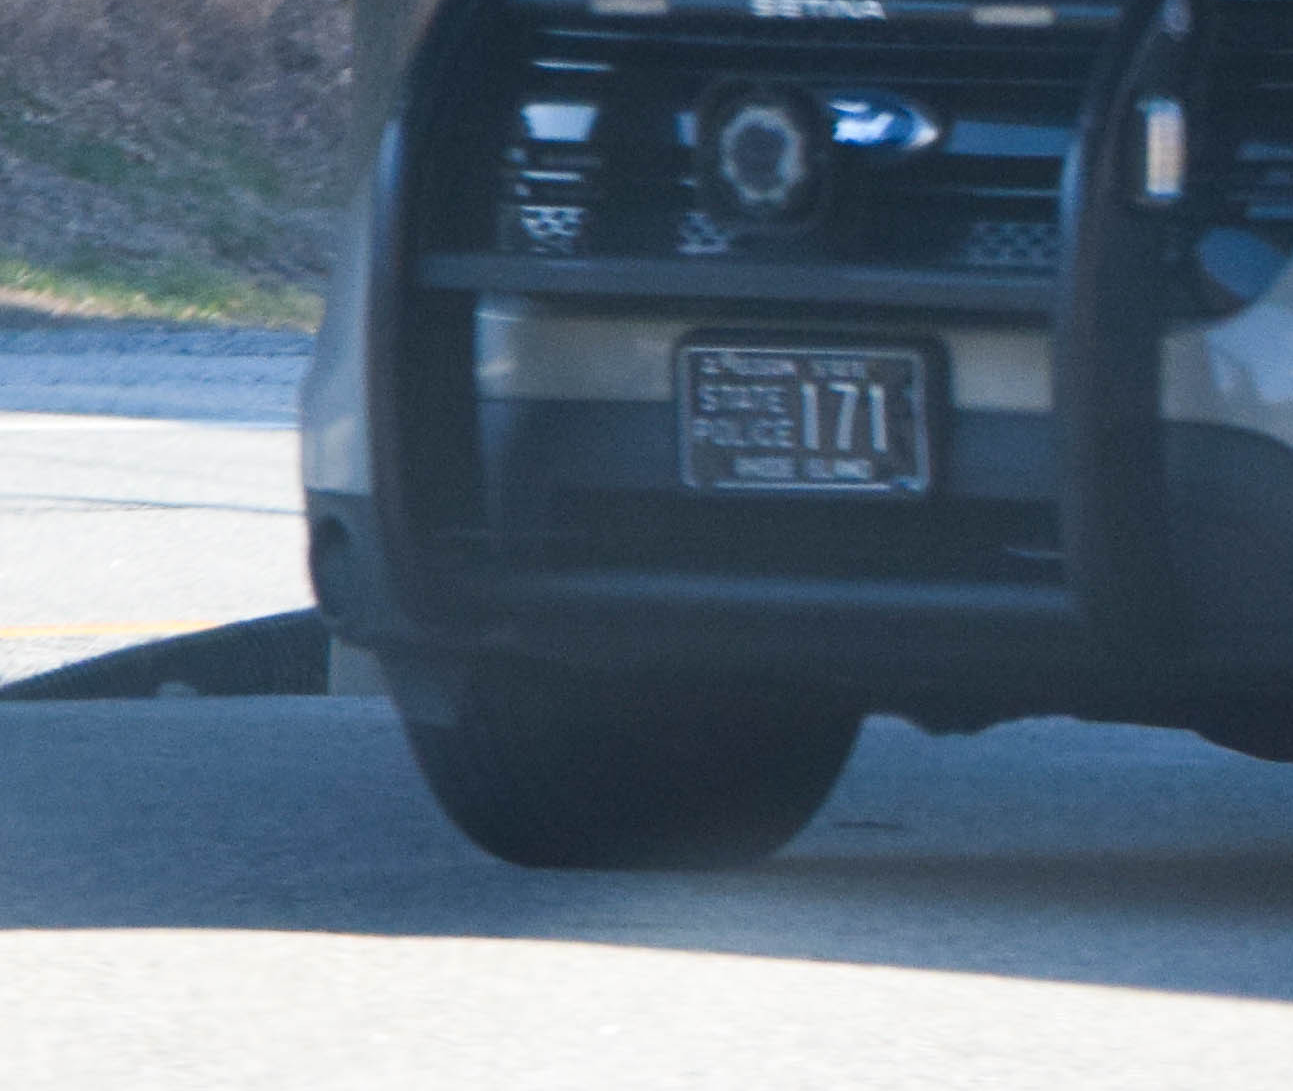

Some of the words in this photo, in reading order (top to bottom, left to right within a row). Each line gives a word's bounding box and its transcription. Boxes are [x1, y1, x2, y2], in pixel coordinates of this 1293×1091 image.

[698, 384, 788, 412] STATE
[692, 417, 796, 449] POLICE
[800, 382, 888, 453] 171
